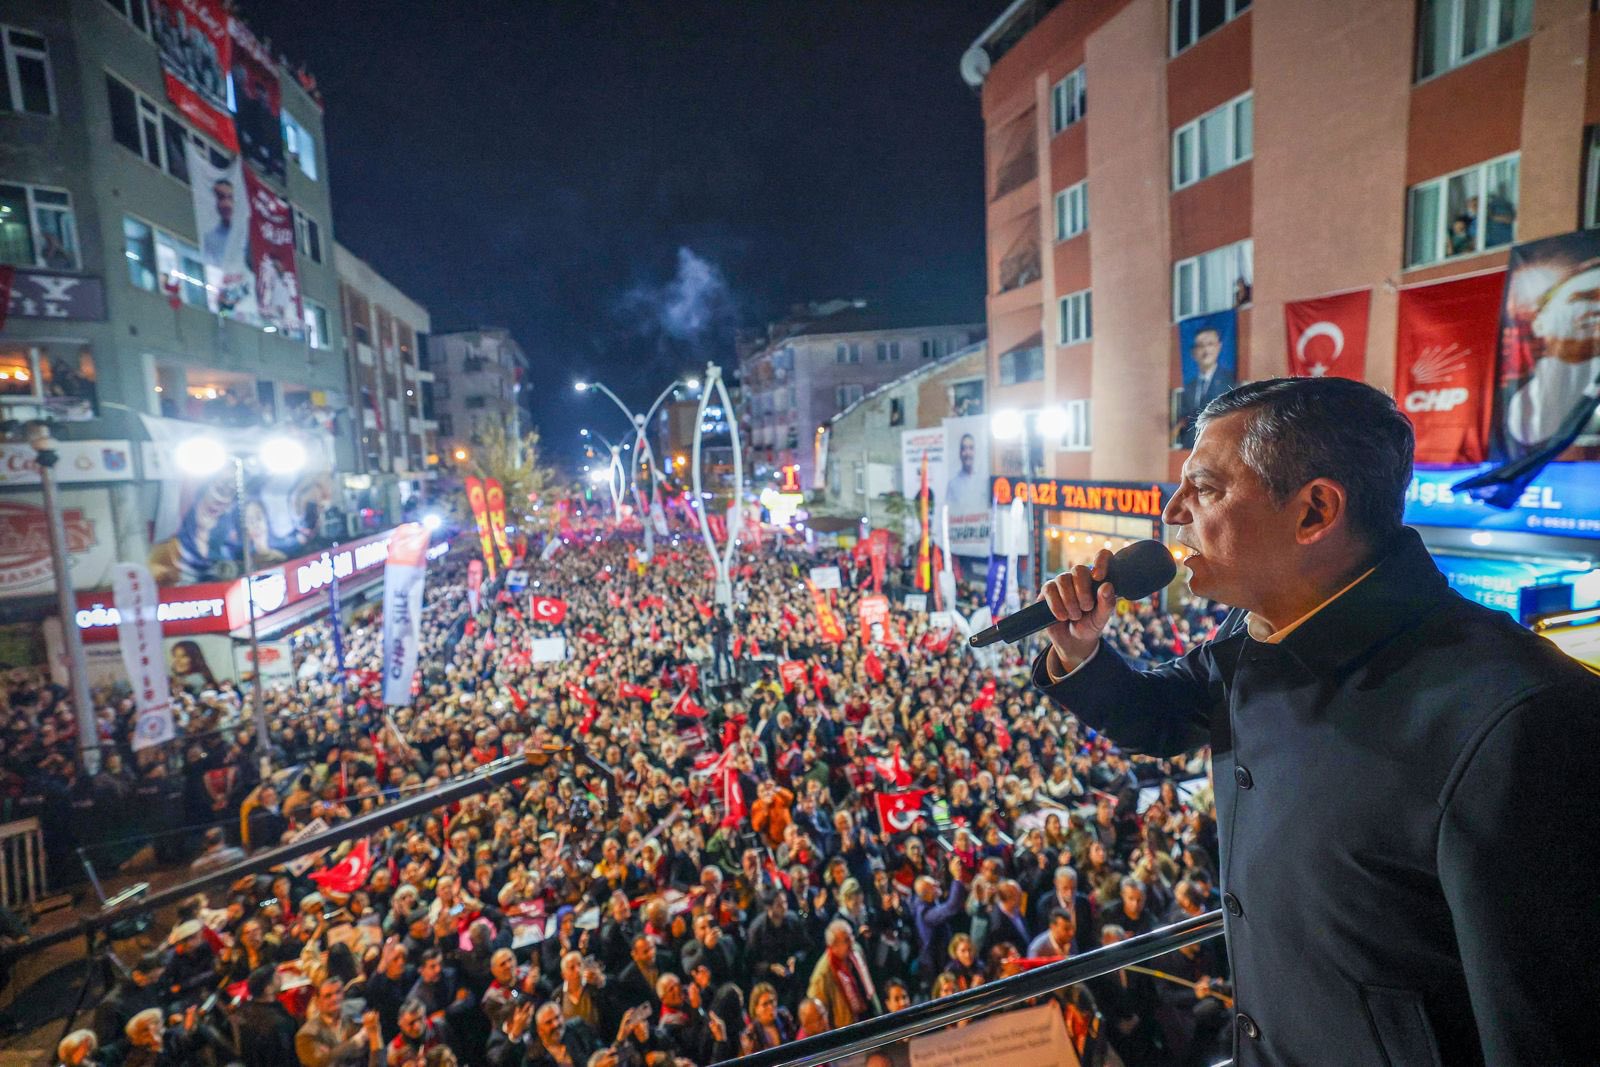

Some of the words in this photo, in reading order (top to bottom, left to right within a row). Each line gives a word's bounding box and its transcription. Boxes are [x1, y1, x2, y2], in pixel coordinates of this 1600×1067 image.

[1404, 387, 1470, 413] CHP
[1014, 480, 1058, 506] GAZİ
[1061, 484, 1162, 516] TANTUNİ
[1405, 478, 1455, 506] İŞE
[1448, 572, 1515, 593] TOMBUL
[157, 598, 225, 622] ARKET
[1475, 591, 1519, 609] TEKE
